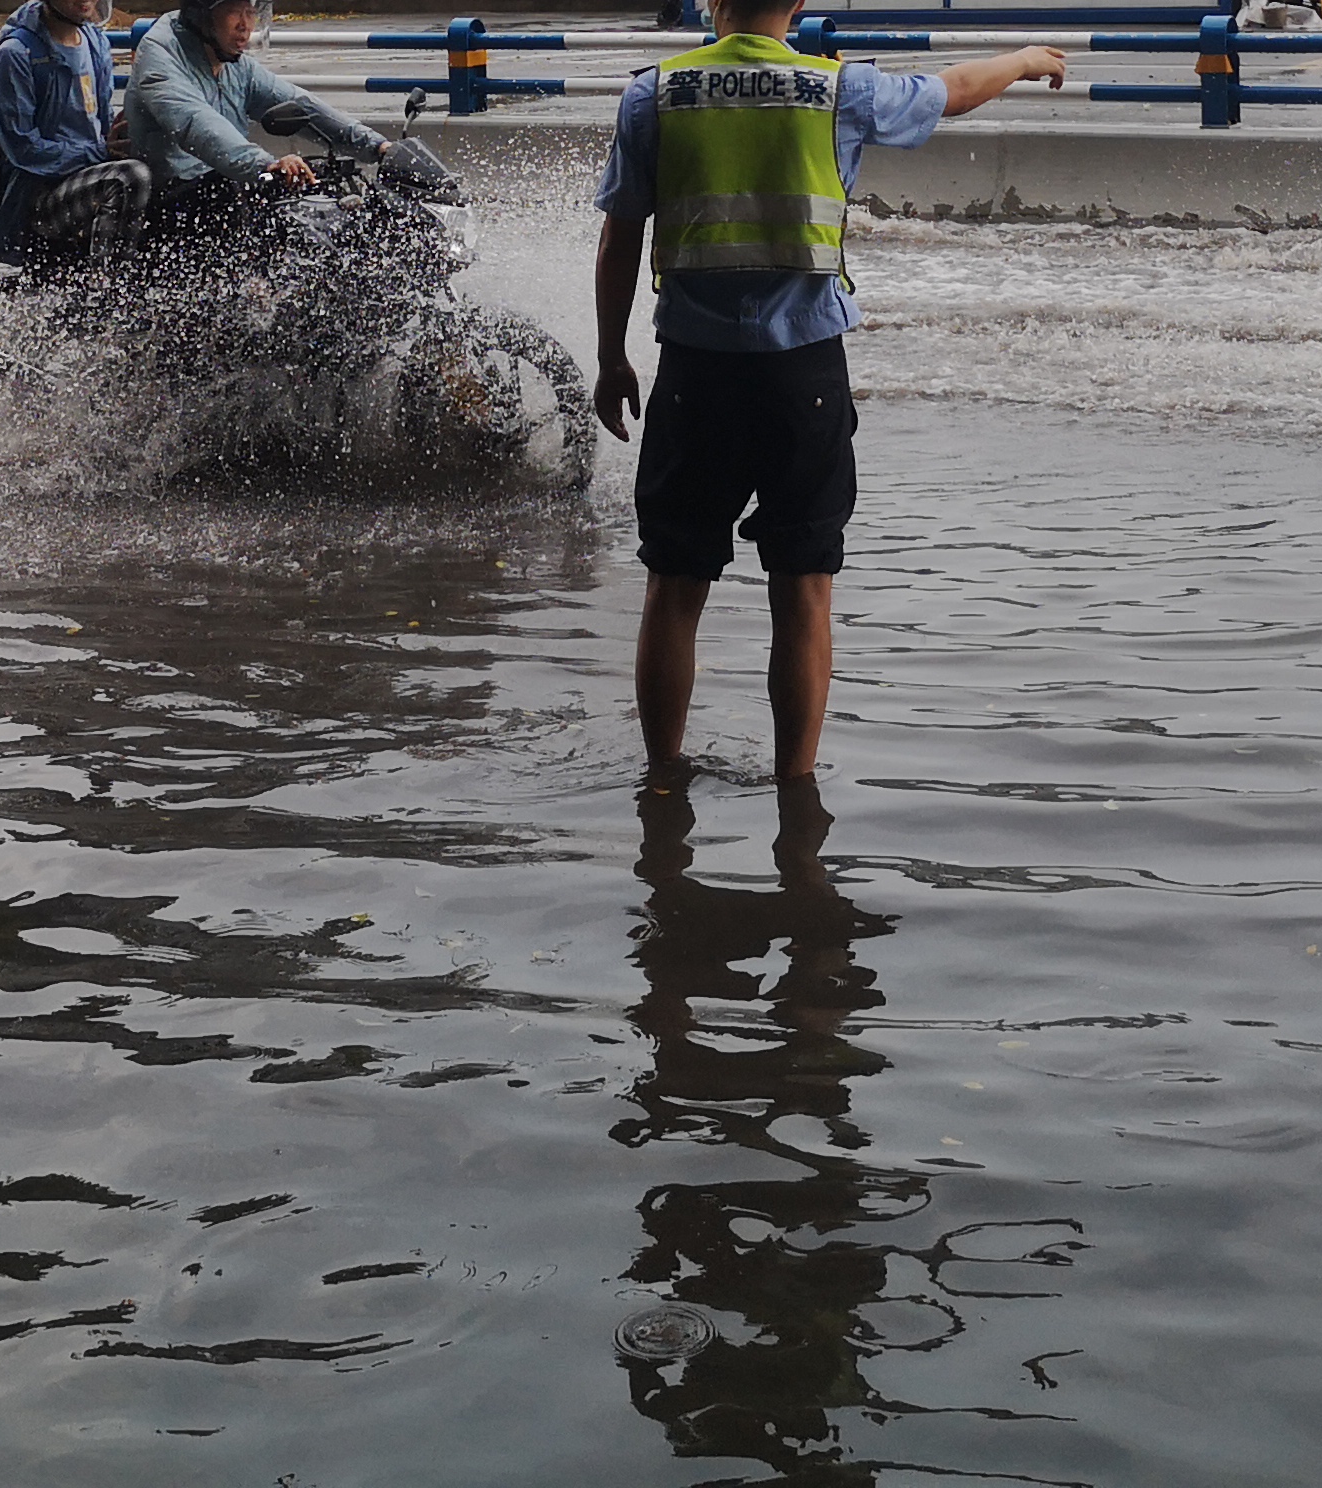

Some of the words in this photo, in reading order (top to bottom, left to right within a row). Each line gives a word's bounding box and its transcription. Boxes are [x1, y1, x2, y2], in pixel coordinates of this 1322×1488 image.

[667, 69, 703, 106] 警
[708, 71, 786, 98] POLICE
[793, 70, 829, 104] 察
